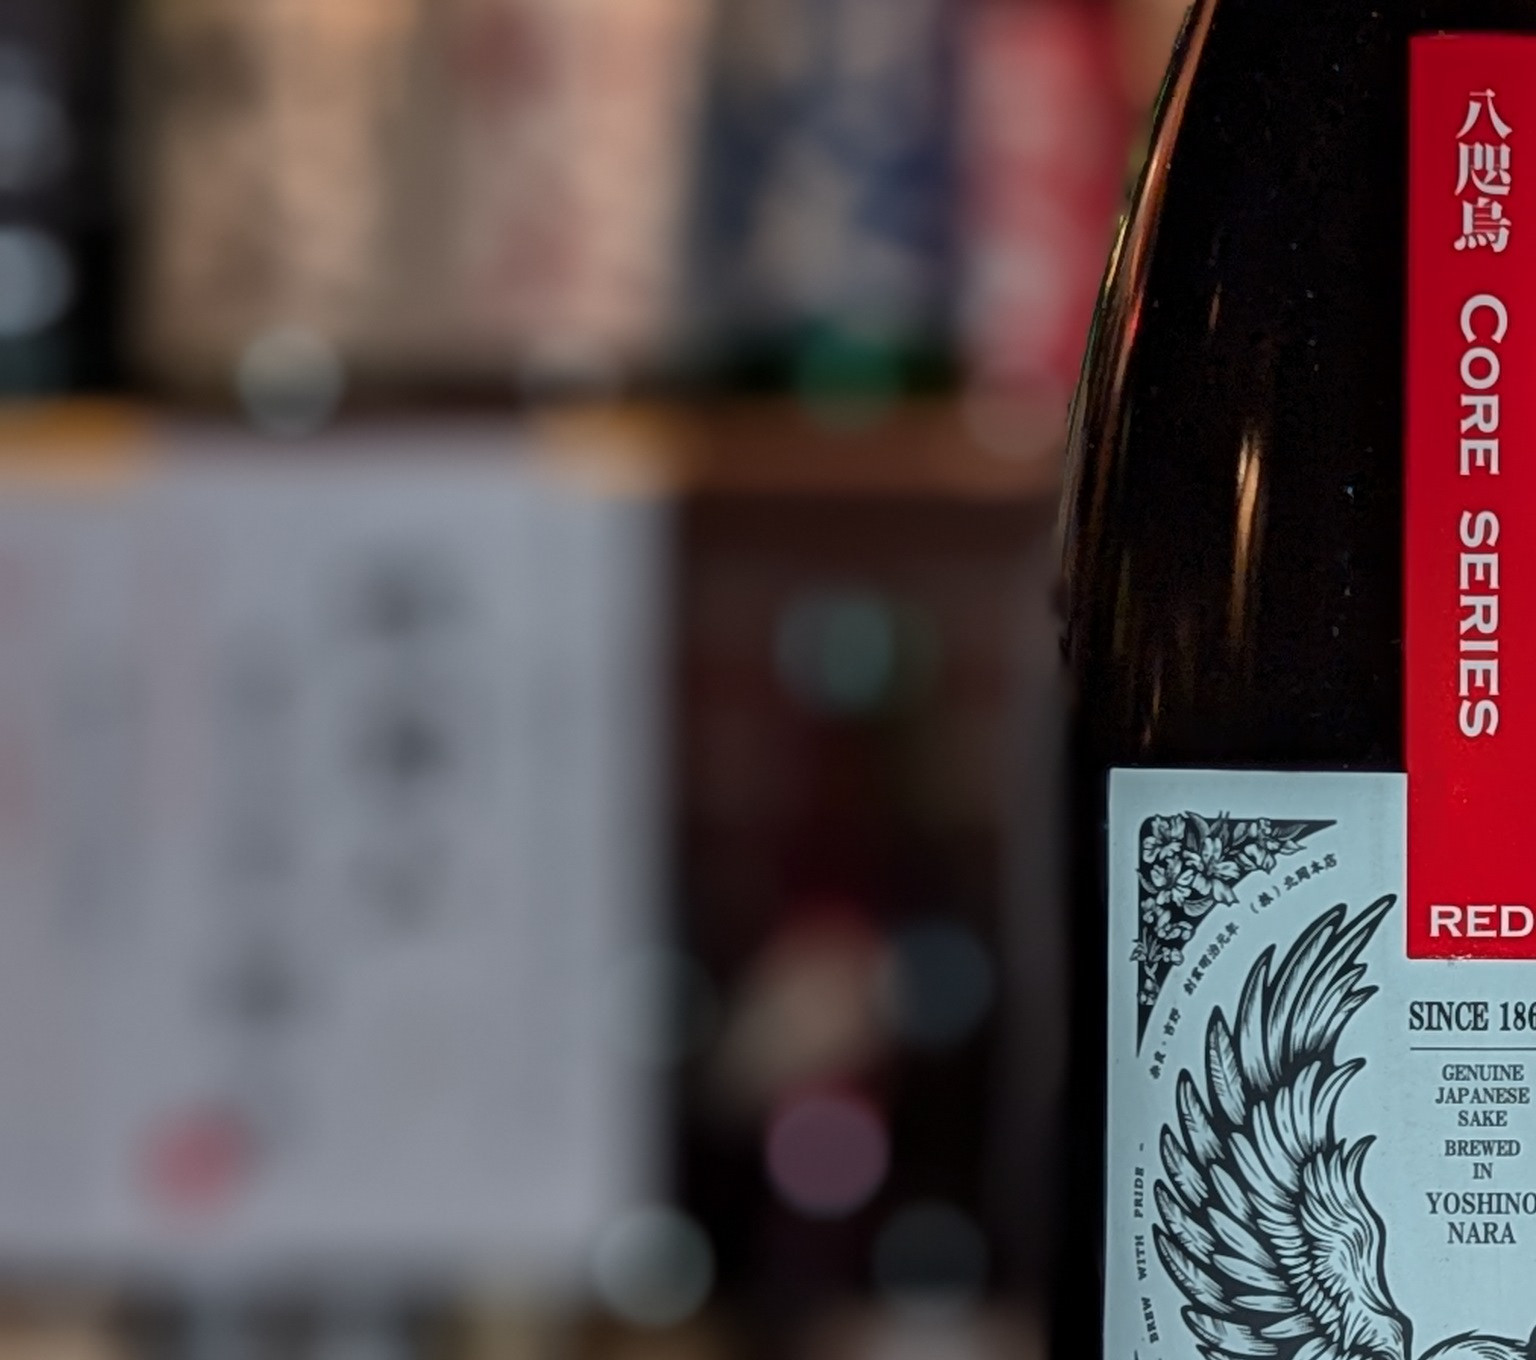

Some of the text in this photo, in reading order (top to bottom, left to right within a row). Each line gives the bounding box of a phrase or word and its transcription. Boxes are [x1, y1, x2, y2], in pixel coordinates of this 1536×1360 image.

[1458, 293, 1509, 739] CORE SERIES
[1429, 904, 1535, 938] RED
[1408, 1000, 1489, 1032] SINCE
[1441, 1064, 1525, 1082] GENUINE
[1434, 1087, 1531, 1105] JAPANESE
[1457, 1110, 1508, 1128] SAKE
[1444, 1139, 1521, 1157] BREWED
[1472, 1162, 1493, 1180] IN
[1446, 1221, 1517, 1245] NARA
[1133, 1166, 1160, 1344] BREW WITH PRIDE
